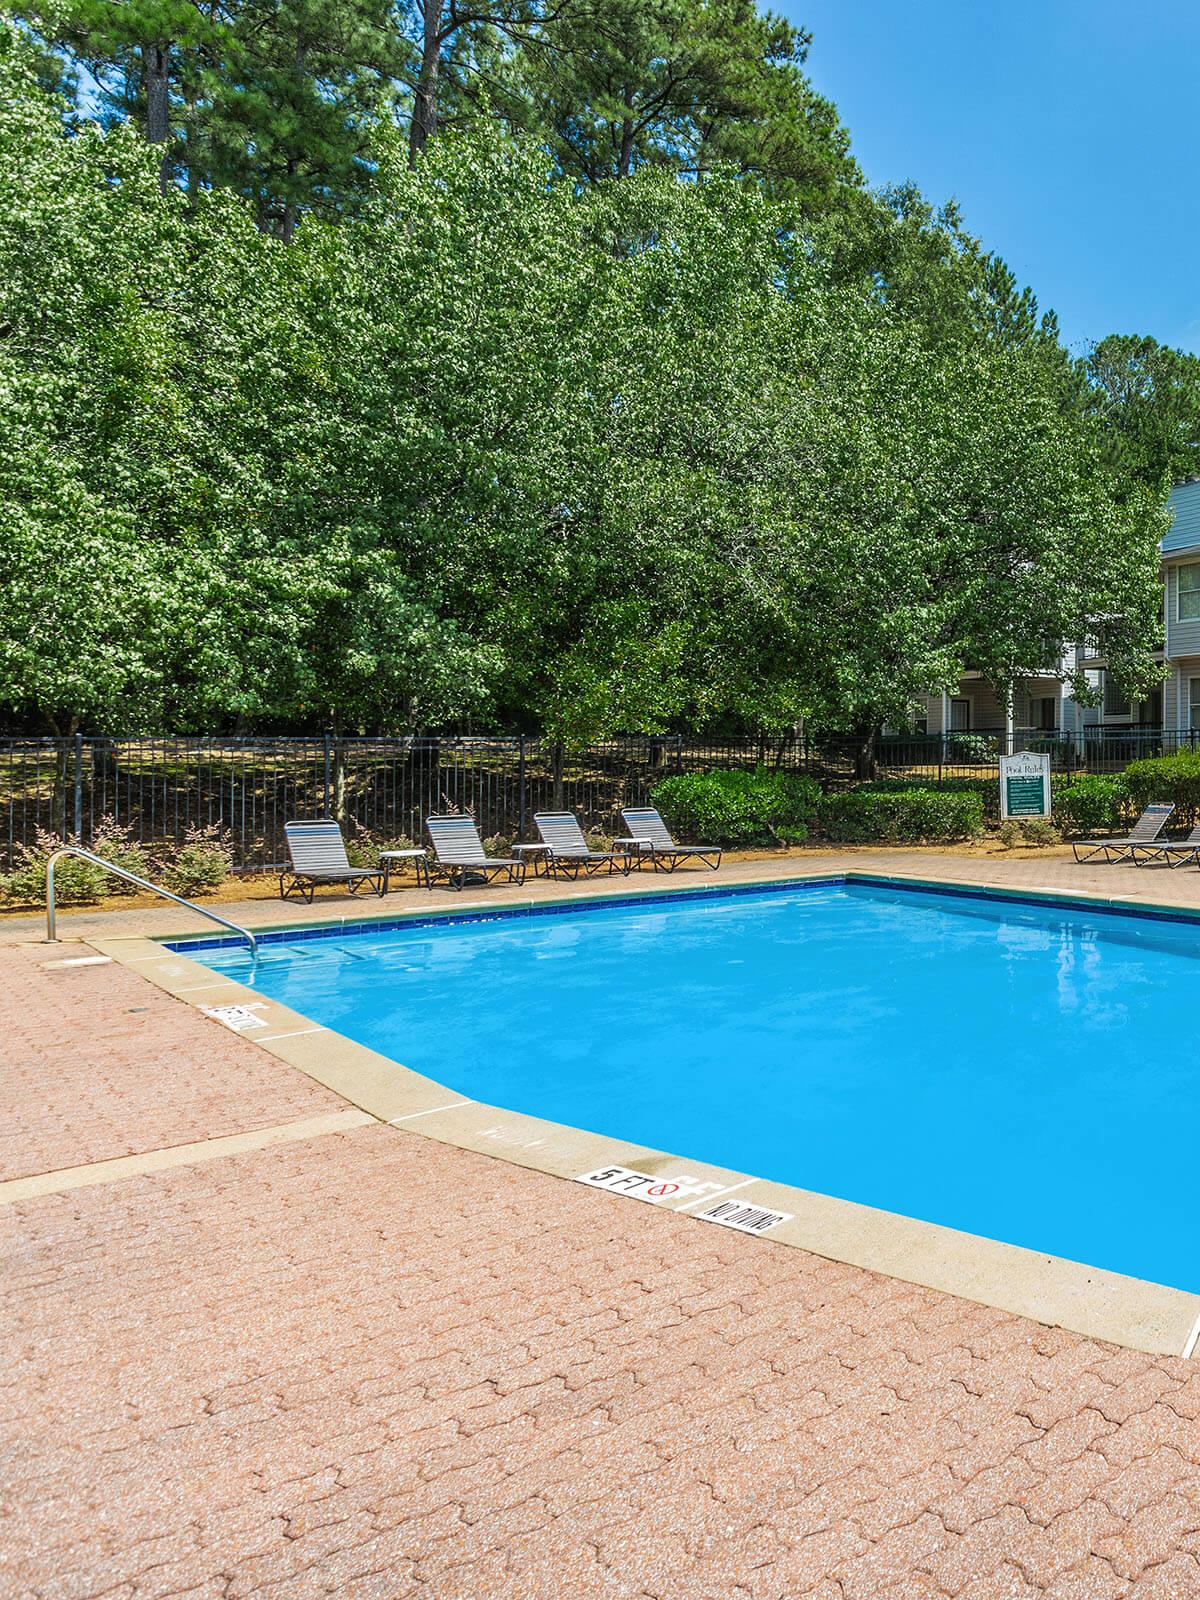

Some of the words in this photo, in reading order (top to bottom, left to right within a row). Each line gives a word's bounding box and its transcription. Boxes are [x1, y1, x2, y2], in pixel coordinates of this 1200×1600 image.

[1006, 765, 1022, 774] Pool
[1025, 764, 1044, 774] Rules
[590, 1168, 619, 1182] 5
[610, 1174, 656, 1191] FT
[703, 1201, 740, 1218] NO
[723, 1207, 784, 1230] DIVING
